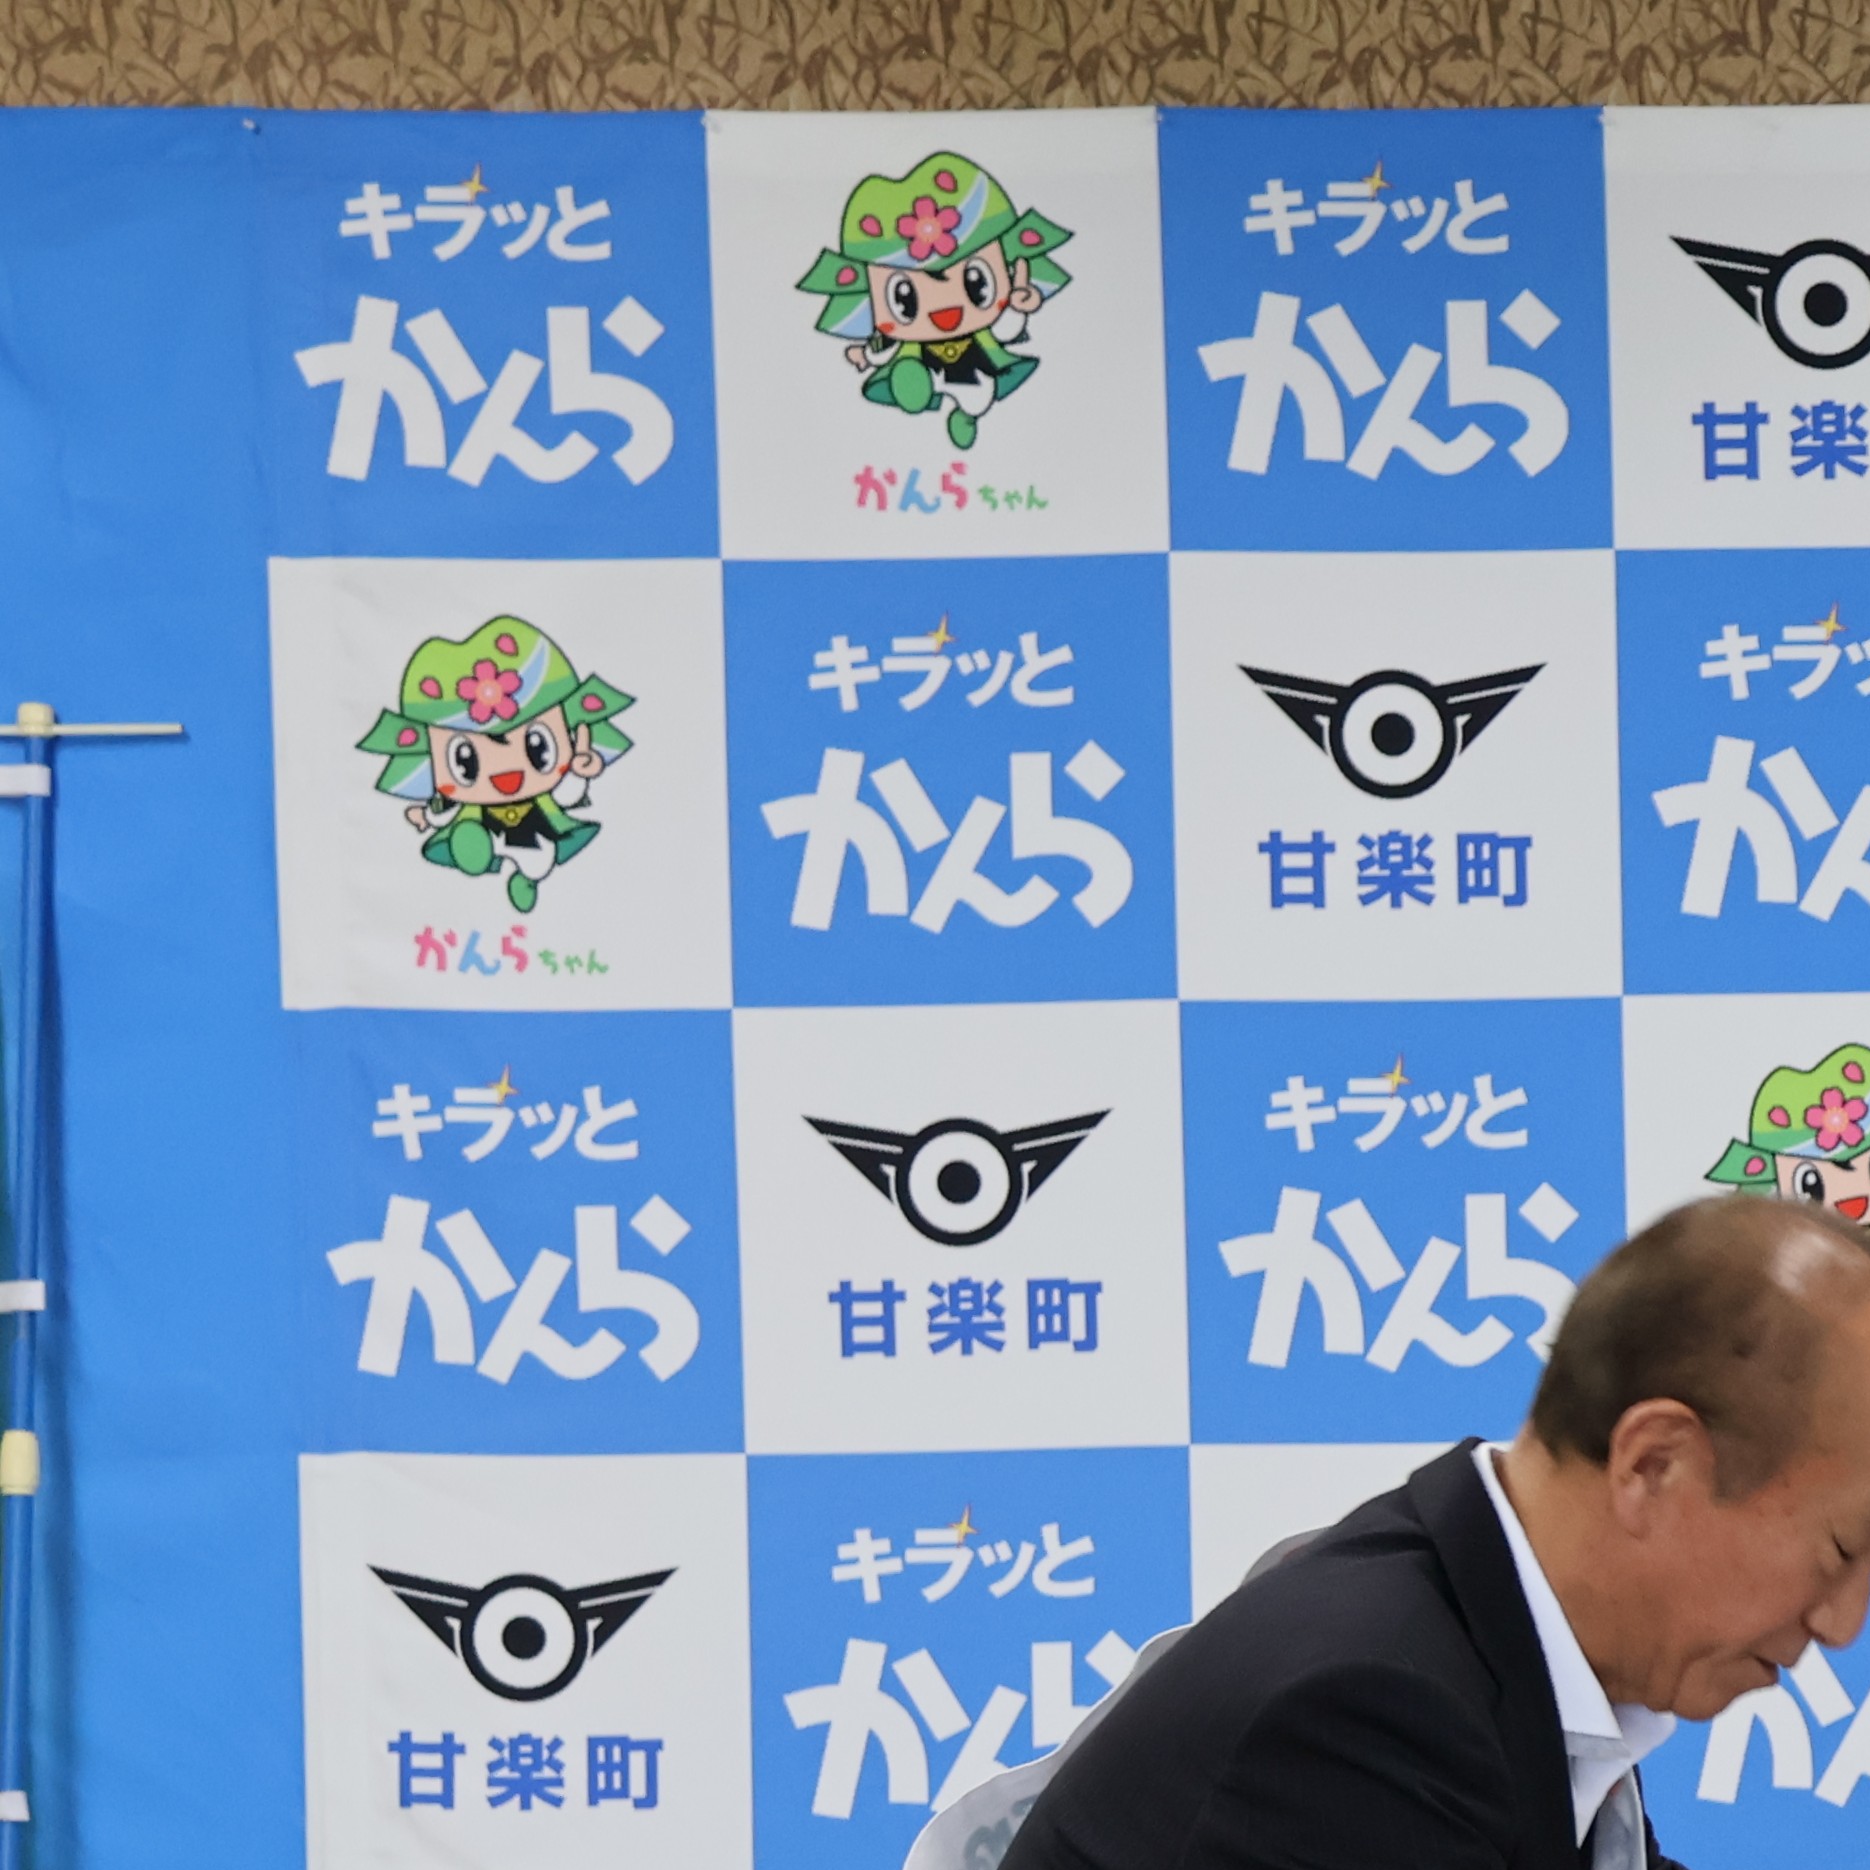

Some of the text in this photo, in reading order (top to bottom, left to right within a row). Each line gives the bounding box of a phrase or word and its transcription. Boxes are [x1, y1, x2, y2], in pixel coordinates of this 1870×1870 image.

[340, 181, 612, 261] キラッと
[1244, 179, 1509, 255] キラッと
[294, 295, 674, 486] かんら
[1198, 290, 1569, 479] かんら
[853, 461, 1047, 514] かんらちゃん
[809, 633, 1074, 712] キラッと
[761, 741, 1133, 933] かんら
[1257, 829, 1534, 910] 甘楽町
[414, 924, 607, 977] かんらちゃん
[372, 1083, 639, 1162] キラッと
[1266, 1073, 1528, 1151] キラッと
[327, 1195, 700, 1384] かんら
[827, 1275, 1104, 1360] 甘楽町
[1218, 1181, 1580, 1374] かんら
[832, 1523, 1095, 1603] キラッと
[386, 1729, 665, 1813] 甘楽町
